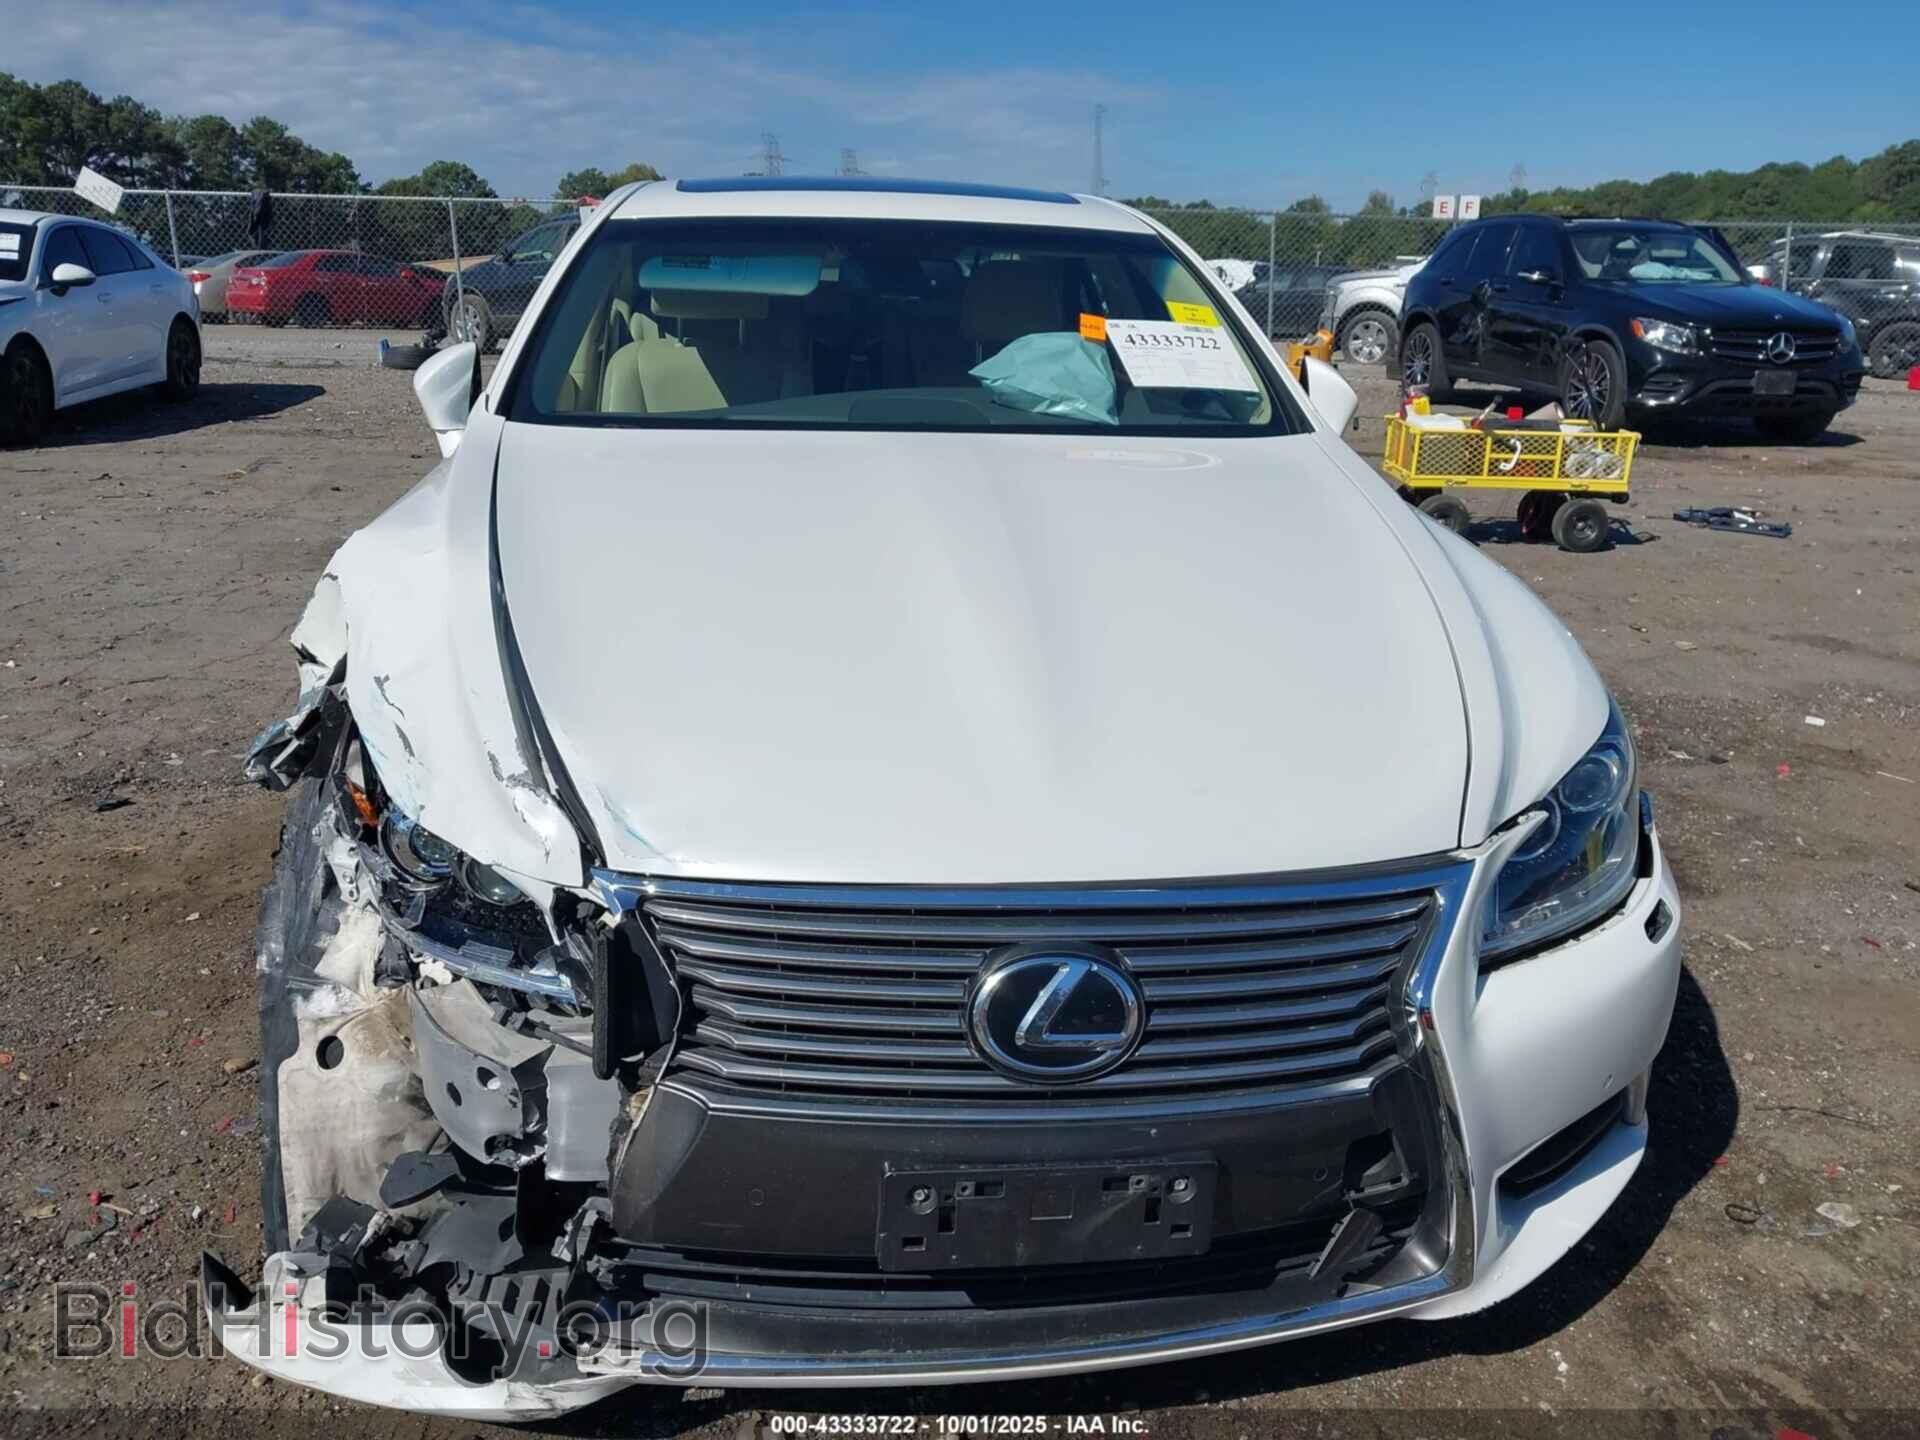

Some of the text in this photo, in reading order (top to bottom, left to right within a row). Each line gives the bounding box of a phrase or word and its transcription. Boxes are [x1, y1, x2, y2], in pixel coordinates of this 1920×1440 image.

[1439, 201, 1449, 214] E
[1464, 201, 1474, 214] F
[1124, 333, 1222, 350] 43333722
